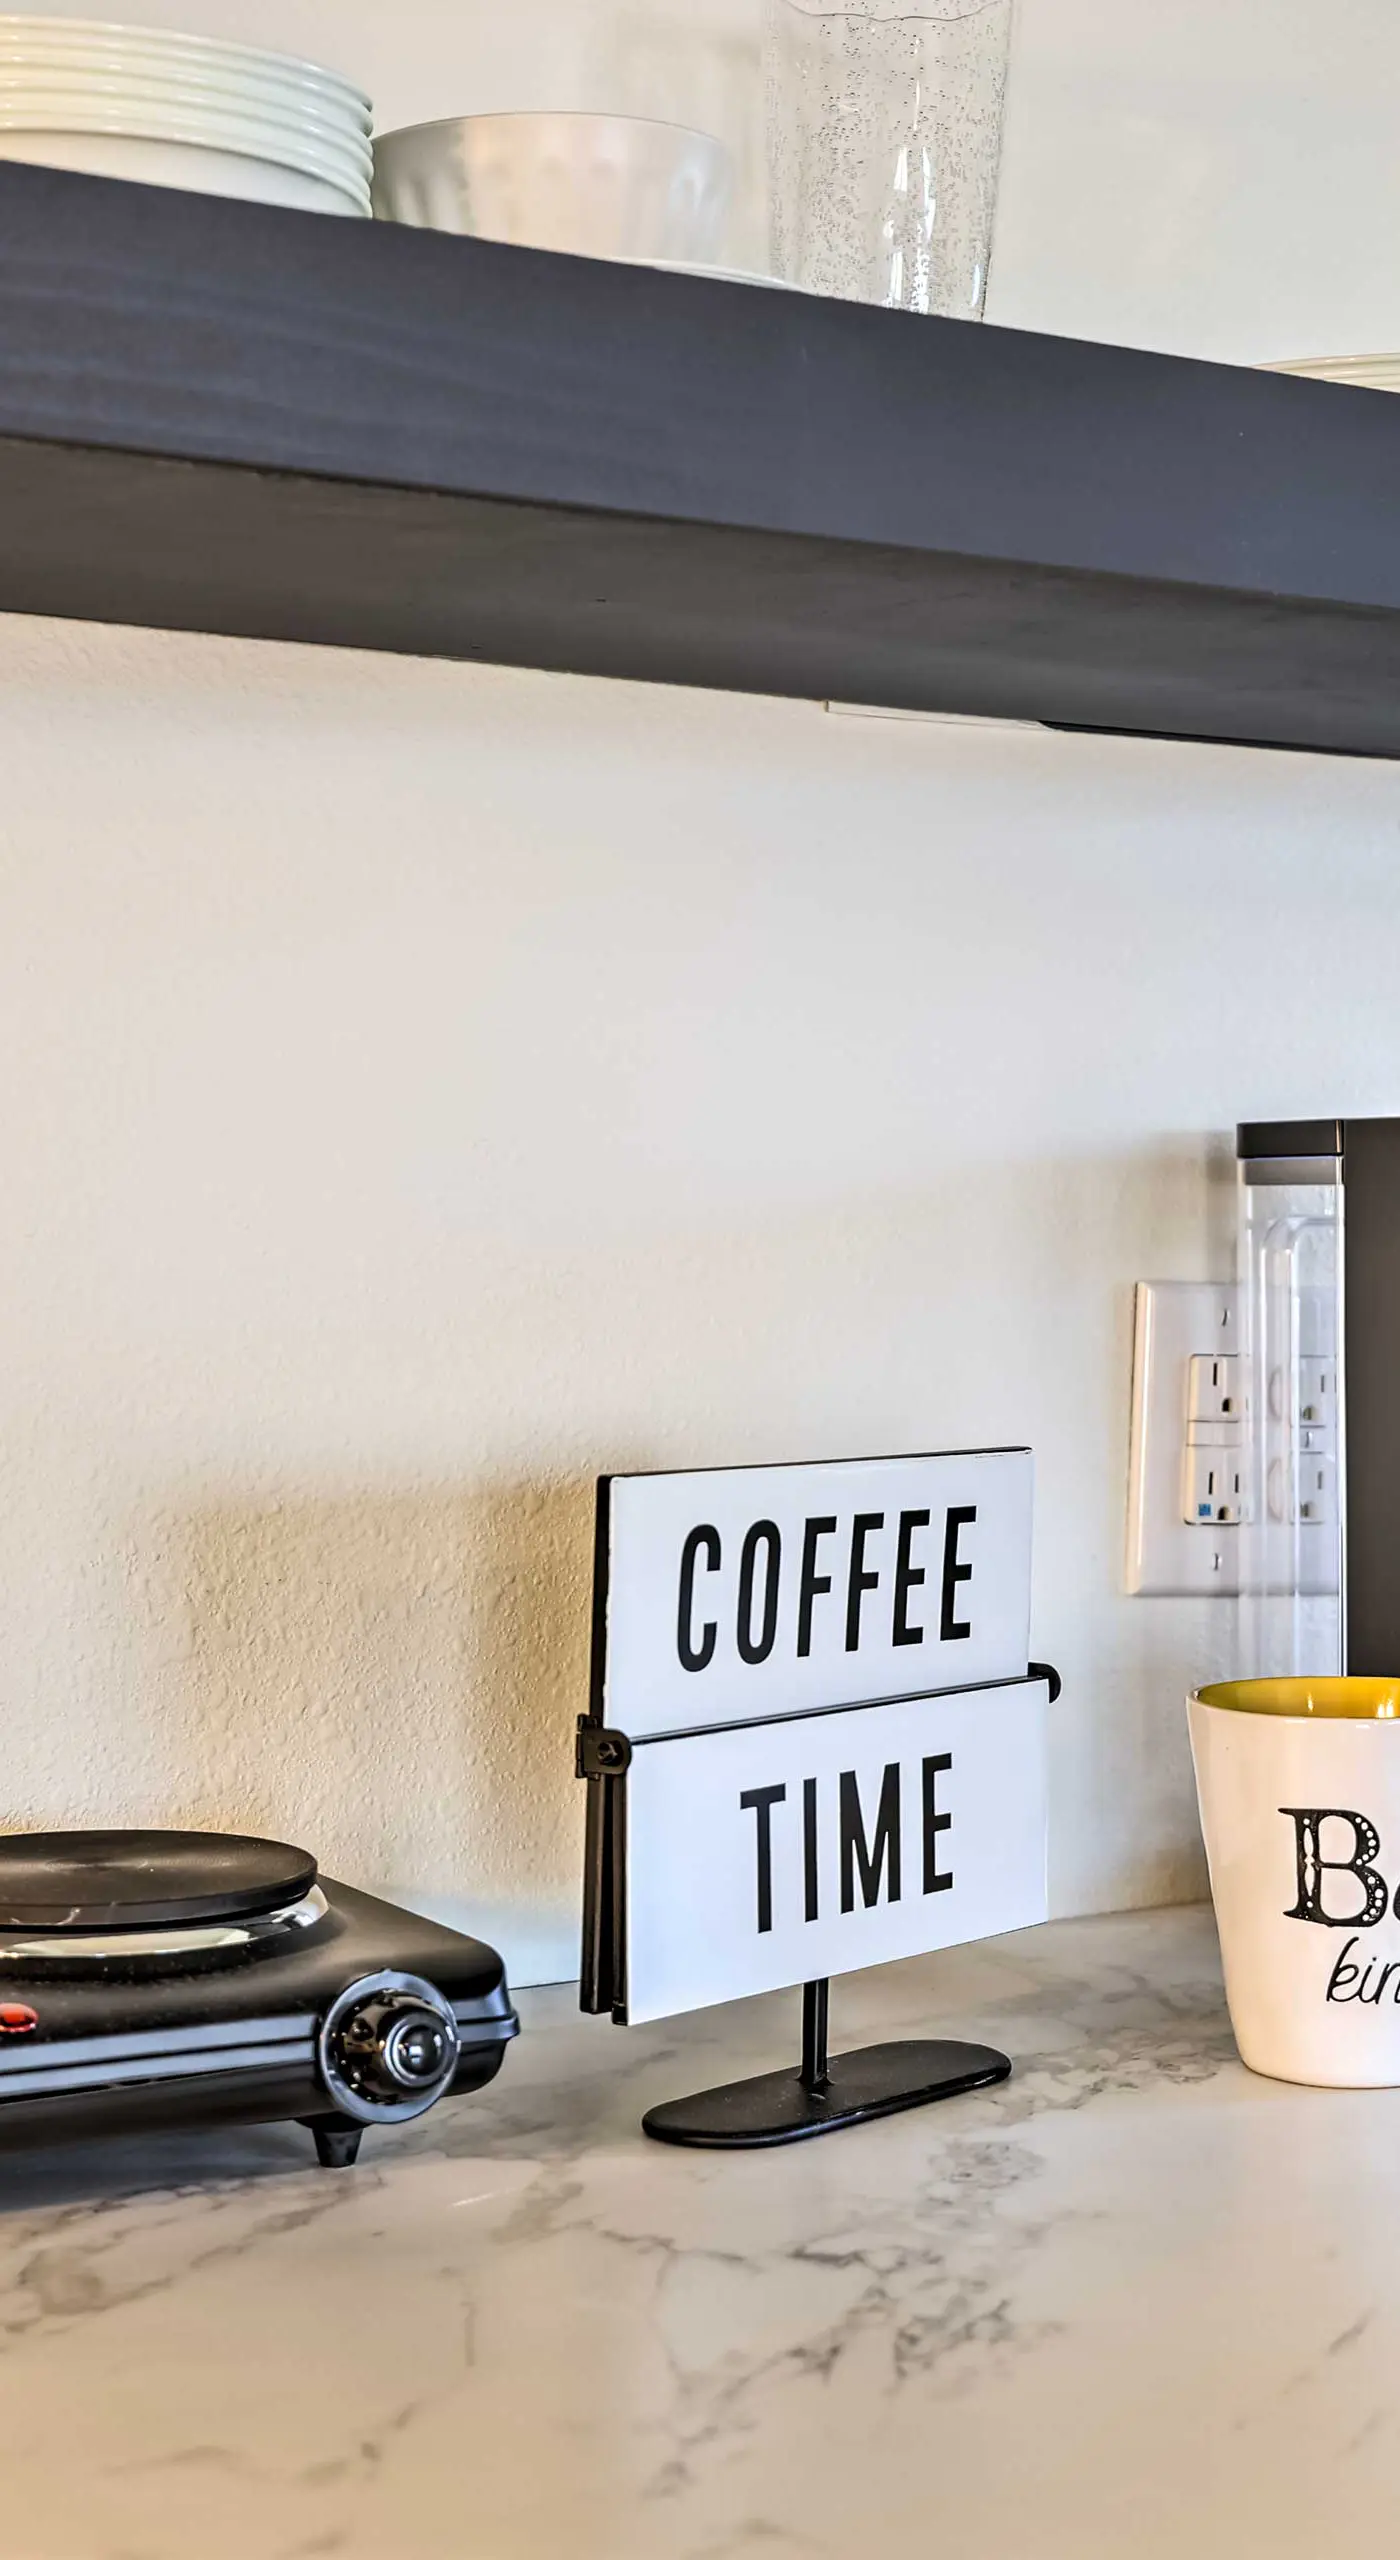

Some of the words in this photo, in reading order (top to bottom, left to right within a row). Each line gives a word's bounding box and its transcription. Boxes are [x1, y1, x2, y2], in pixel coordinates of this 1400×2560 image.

[677, 1505, 977, 1673] COFFEE
[740, 1752, 953, 1934] TIME
[1277, 1807, 1400, 1928] B
